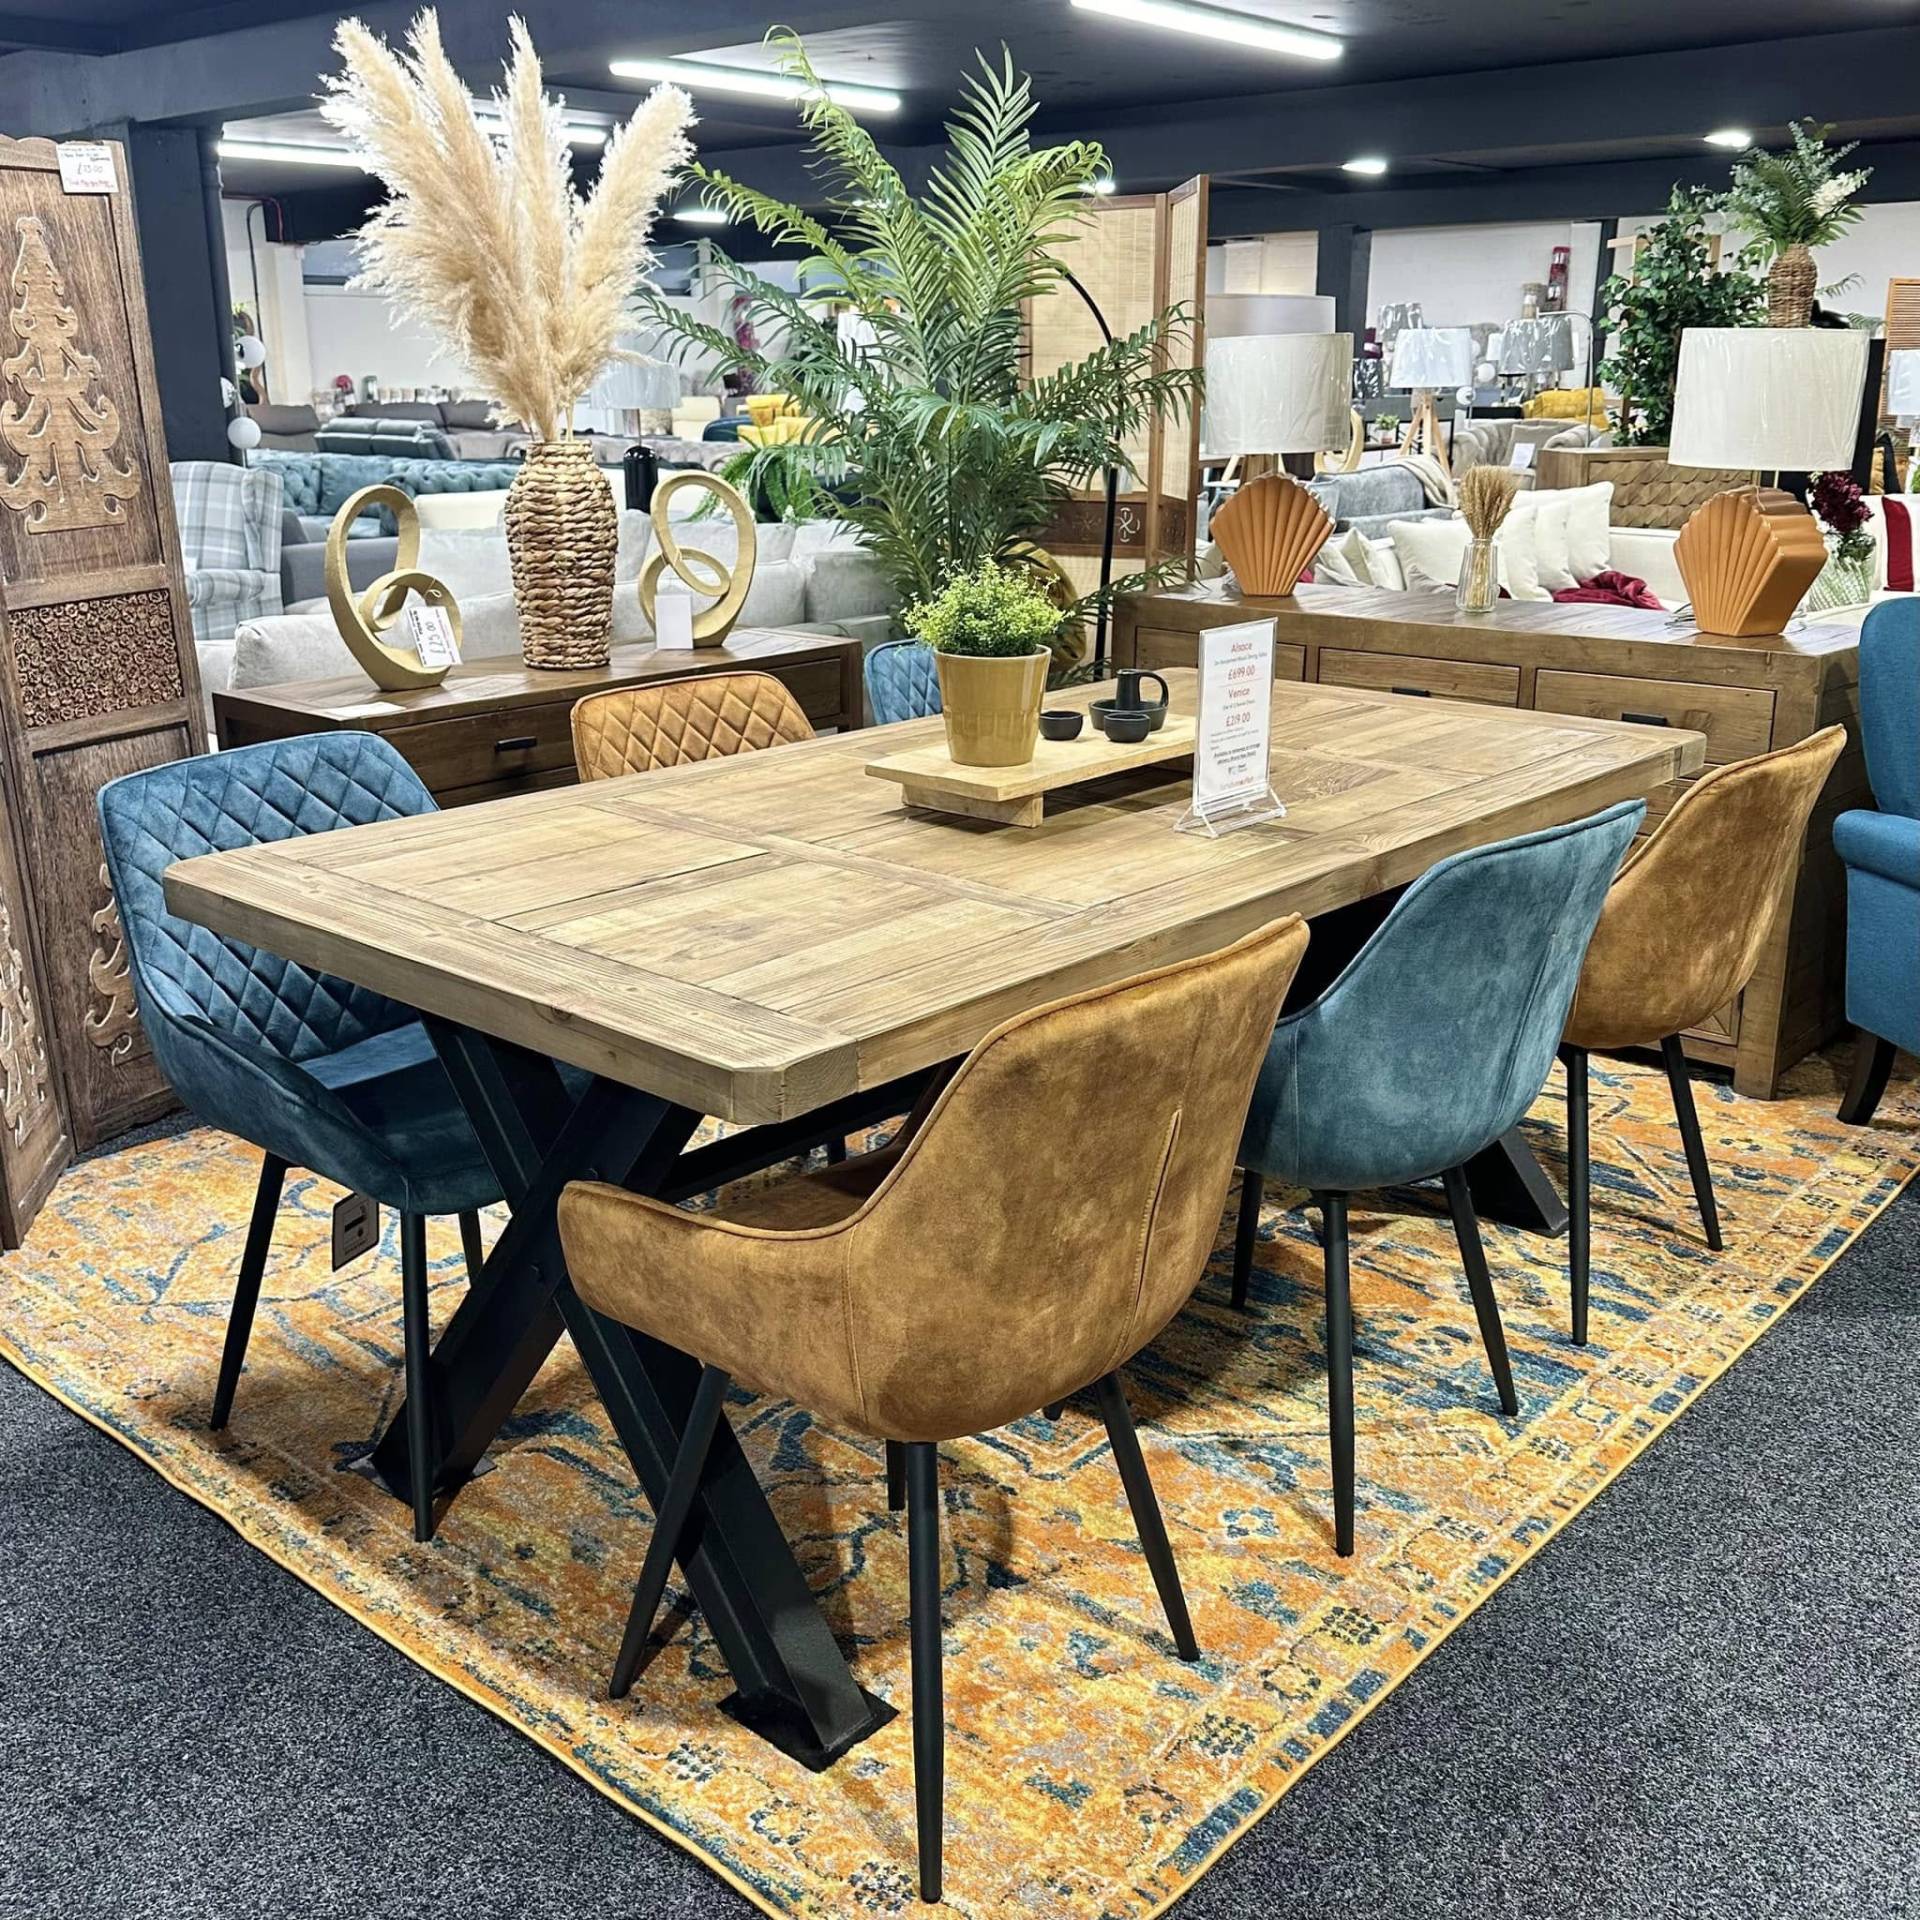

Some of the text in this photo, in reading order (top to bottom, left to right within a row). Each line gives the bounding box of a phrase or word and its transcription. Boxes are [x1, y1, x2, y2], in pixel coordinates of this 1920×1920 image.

[1231, 642, 1253, 653] Alsace
[1228, 664, 1256, 680] £699.00
[1228, 688, 1250, 699] Venice
[1226, 712, 1251, 727] £219.00
